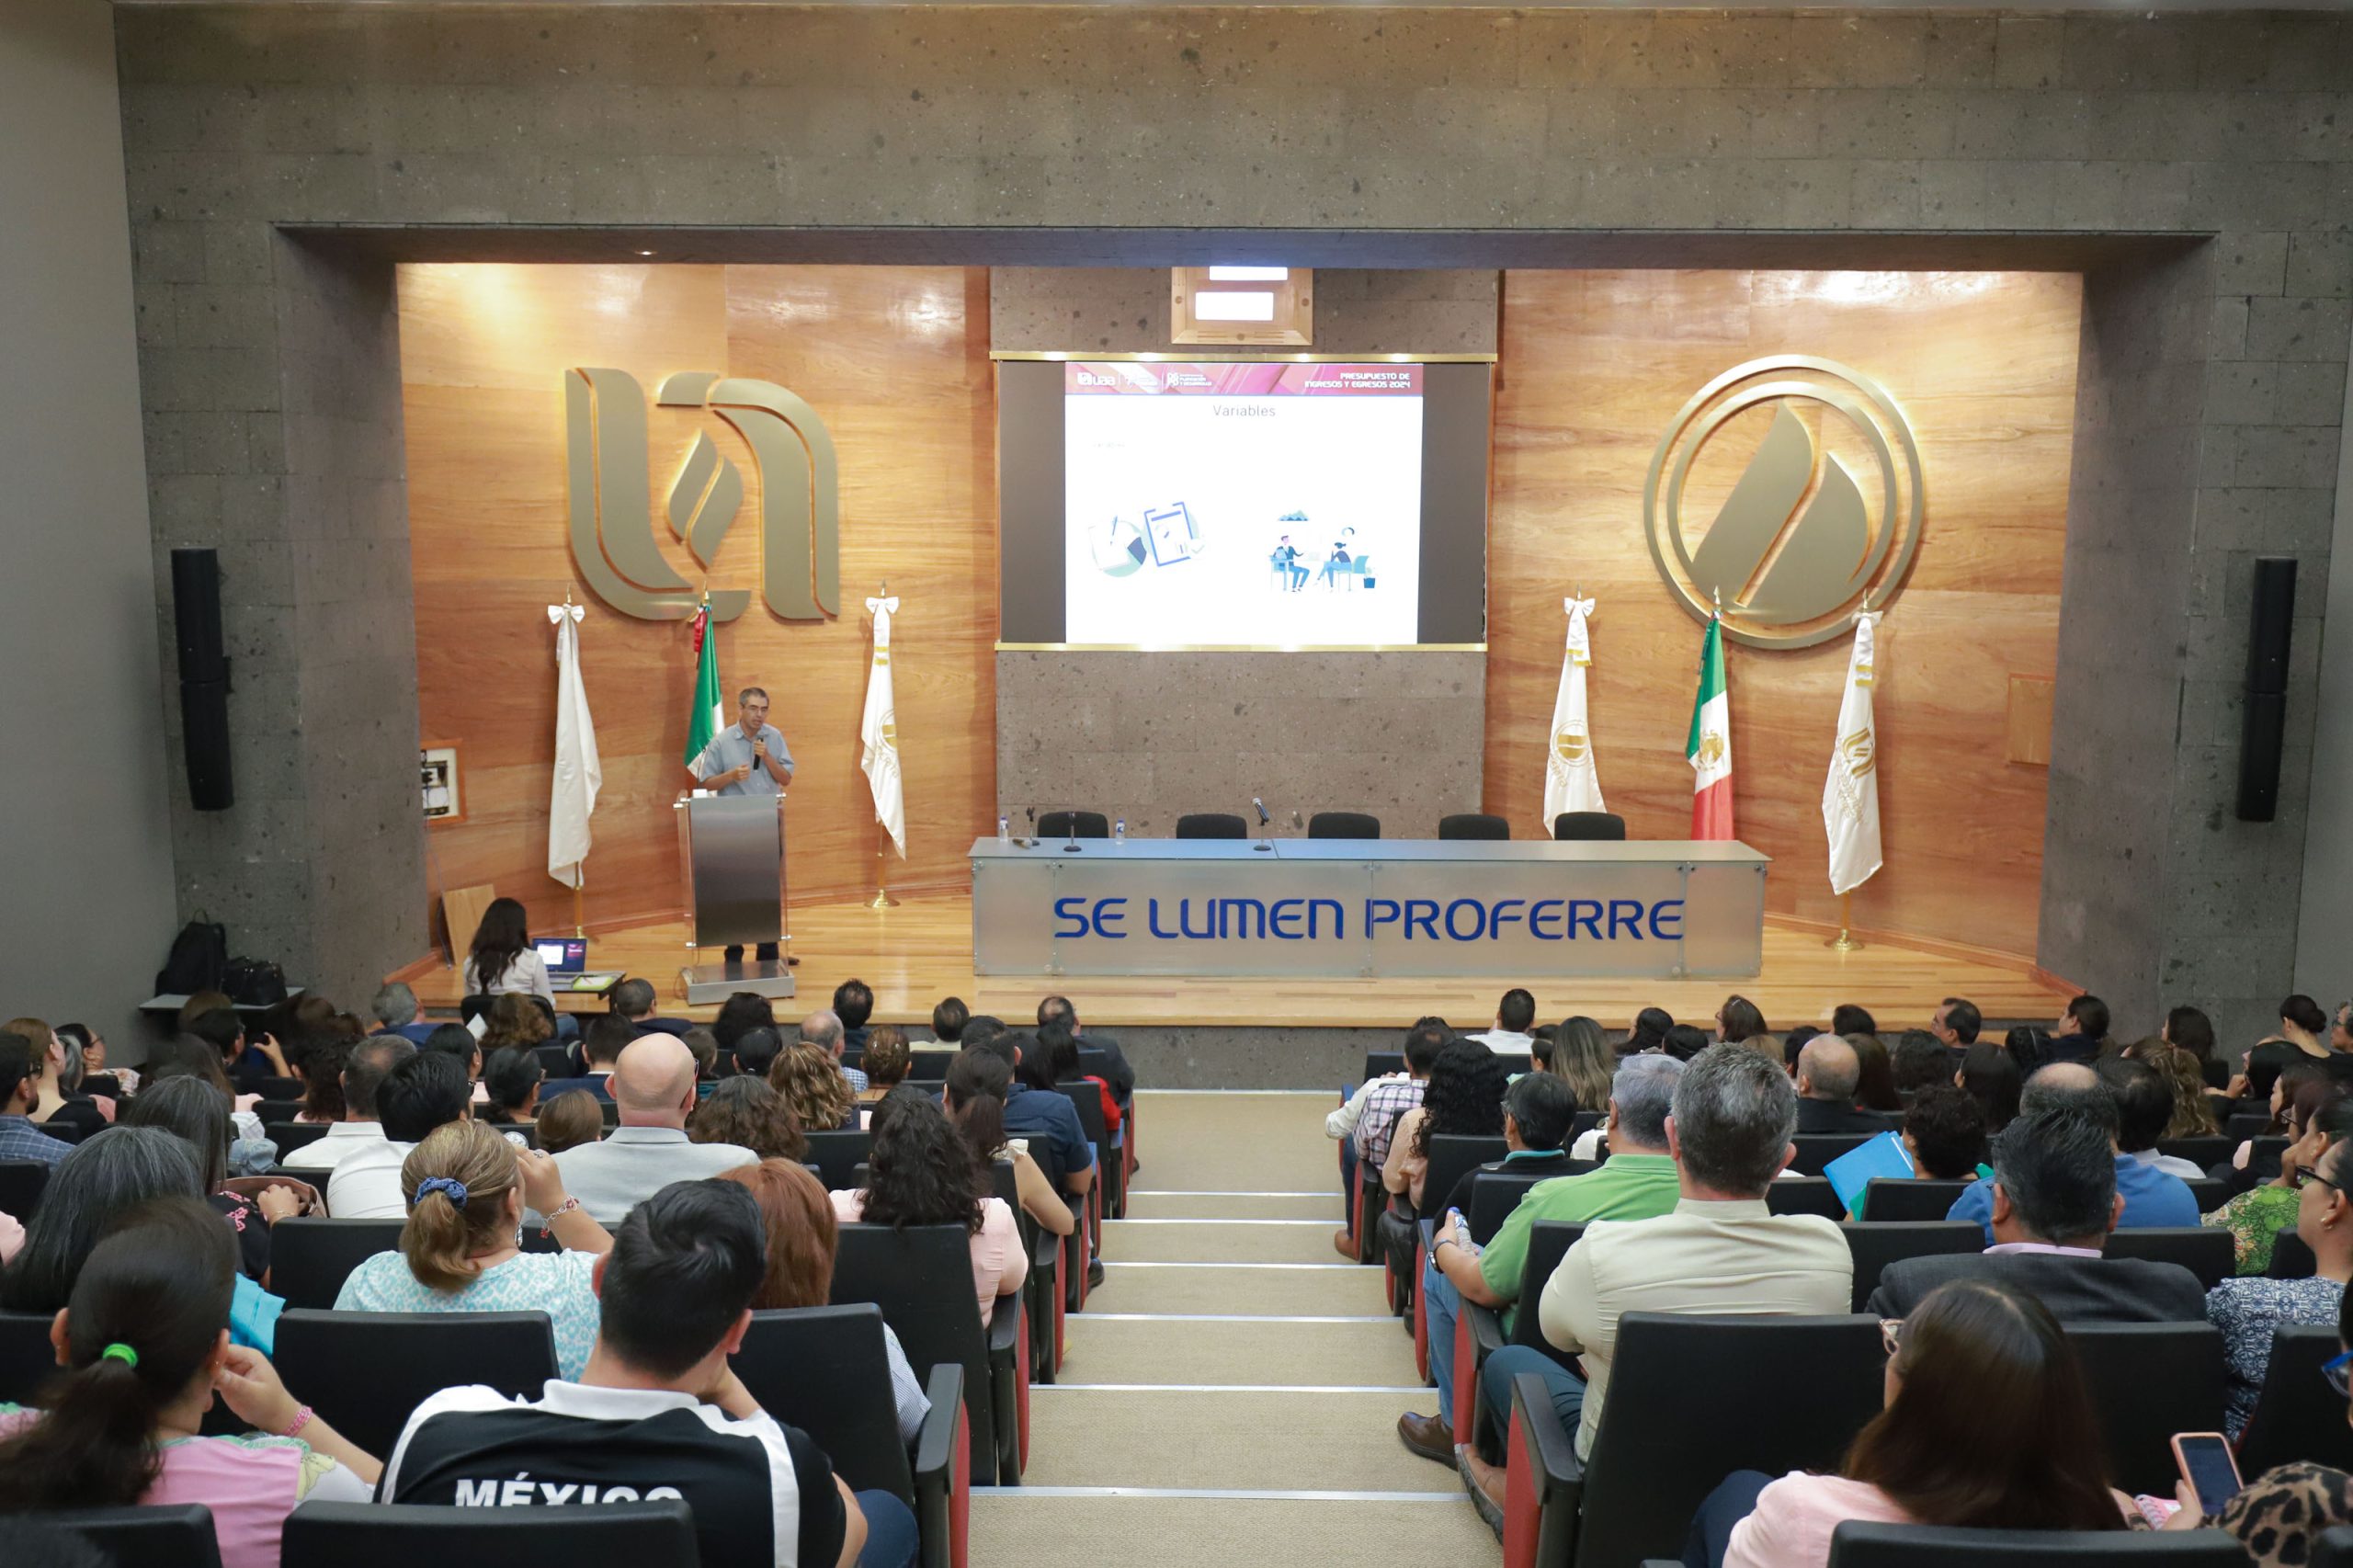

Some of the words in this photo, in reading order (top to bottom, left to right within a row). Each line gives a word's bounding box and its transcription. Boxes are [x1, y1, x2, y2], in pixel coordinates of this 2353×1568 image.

[1212, 404, 1276, 417] Variables
[1053, 897, 1128, 938] SE
[1148, 898, 1345, 939] LUMEN
[1364, 898, 1686, 941] PROFERRE
